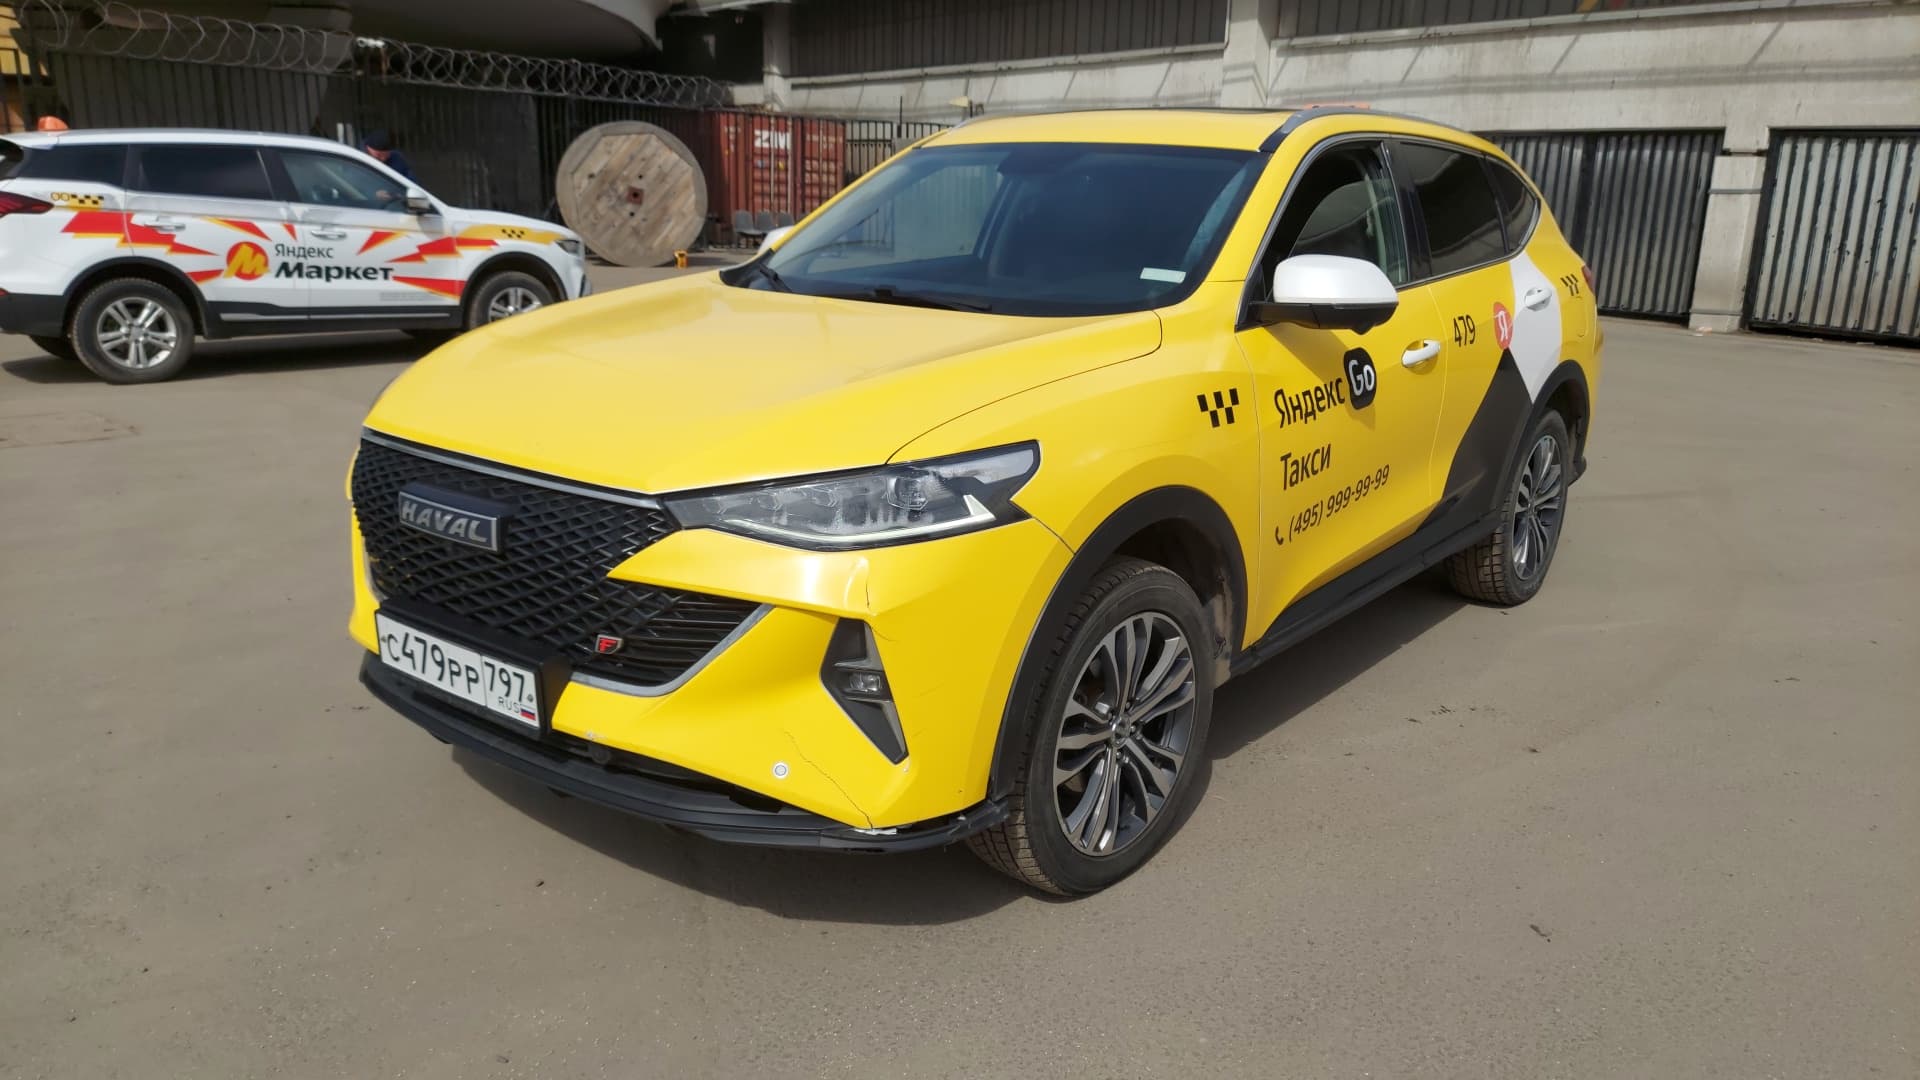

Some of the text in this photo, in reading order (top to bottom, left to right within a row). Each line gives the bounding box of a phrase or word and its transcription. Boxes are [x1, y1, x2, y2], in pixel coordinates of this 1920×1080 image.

[754, 129, 791, 149] ZIM
[274, 243, 334, 259] Яндекс
[274, 261, 395, 283] Маркет
[1452, 314, 1477, 348] 479
[1273, 359, 1376, 429] Яндекс Go
[1280, 443, 1332, 491] Такси
[1288, 464, 1390, 542] (495) 999-99-99
[401, 500, 488, 543] HAVAL
[498, 696, 521, 714] RUS
